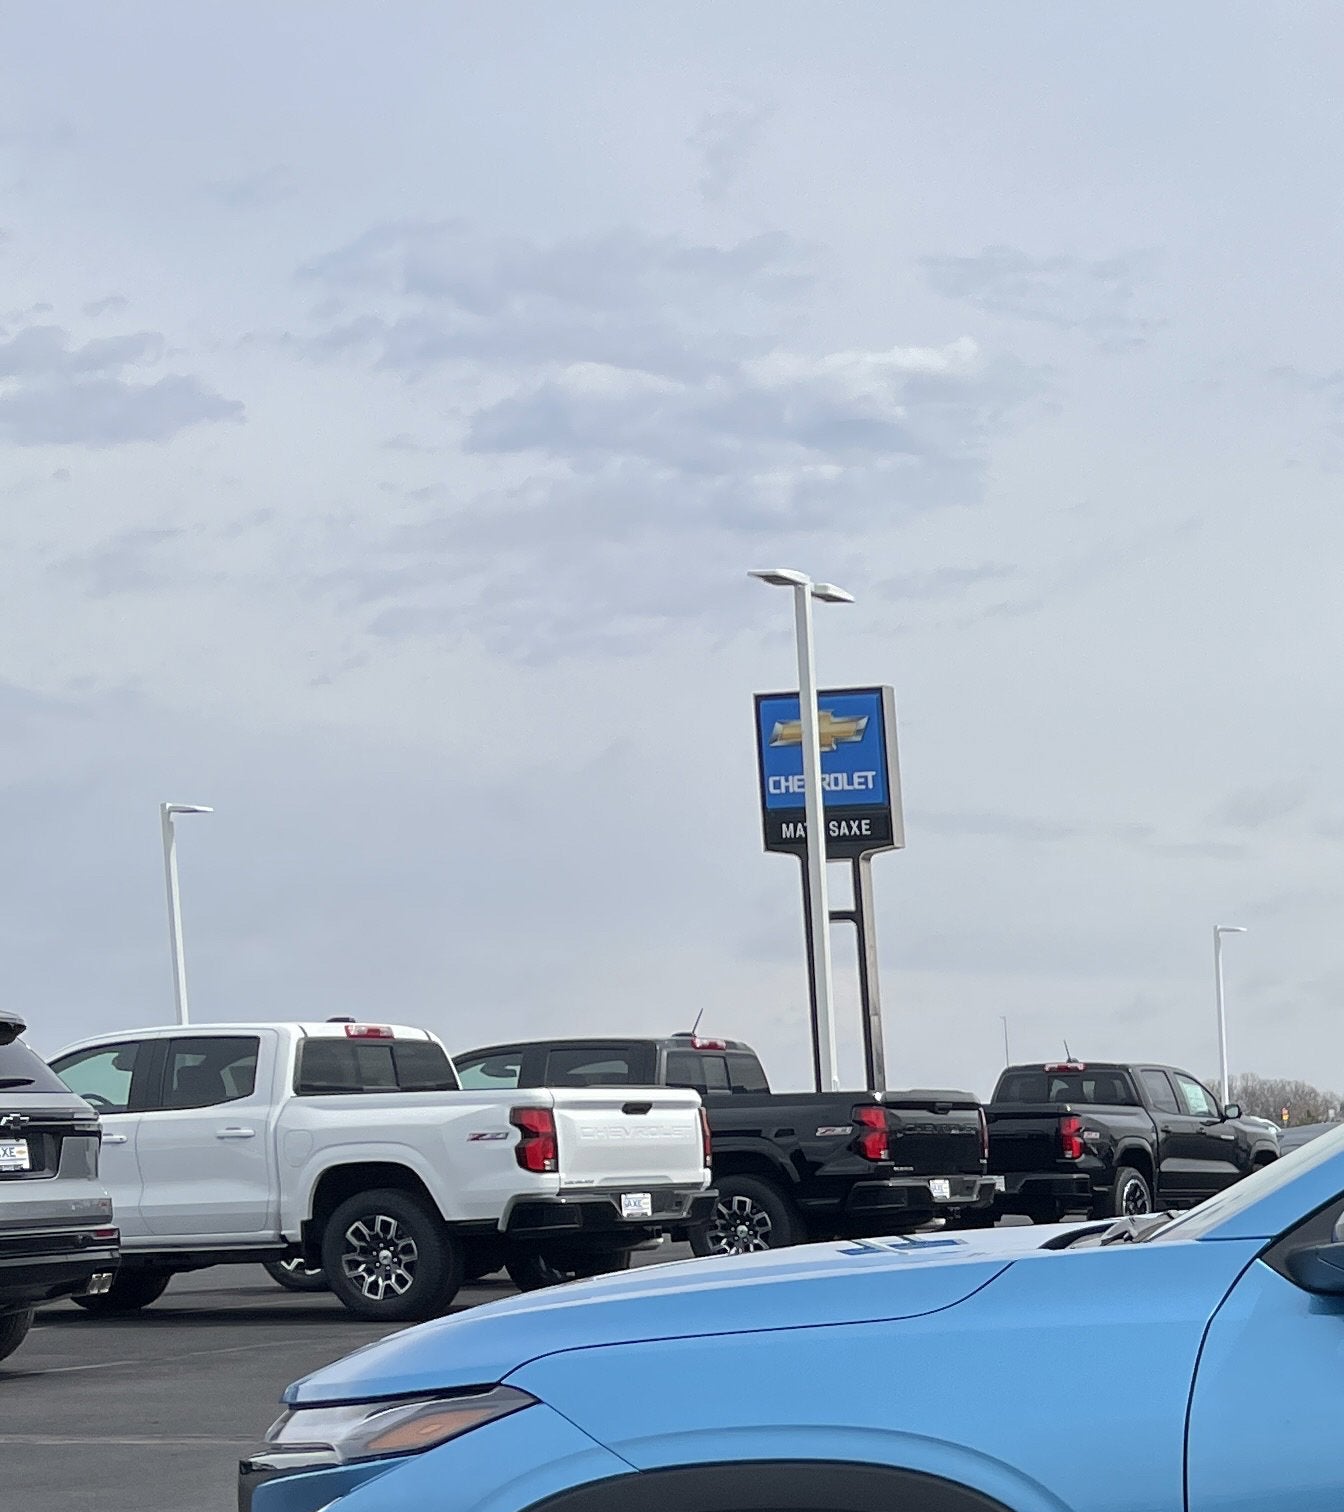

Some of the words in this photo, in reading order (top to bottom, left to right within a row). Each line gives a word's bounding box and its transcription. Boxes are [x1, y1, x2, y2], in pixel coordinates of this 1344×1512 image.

[768, 771, 876, 794] CHEROLET
[829, 819, 871, 837] SAXE
[580, 1125, 693, 1140] CHEVROLET
[0, 1147, 16, 1158] XE
